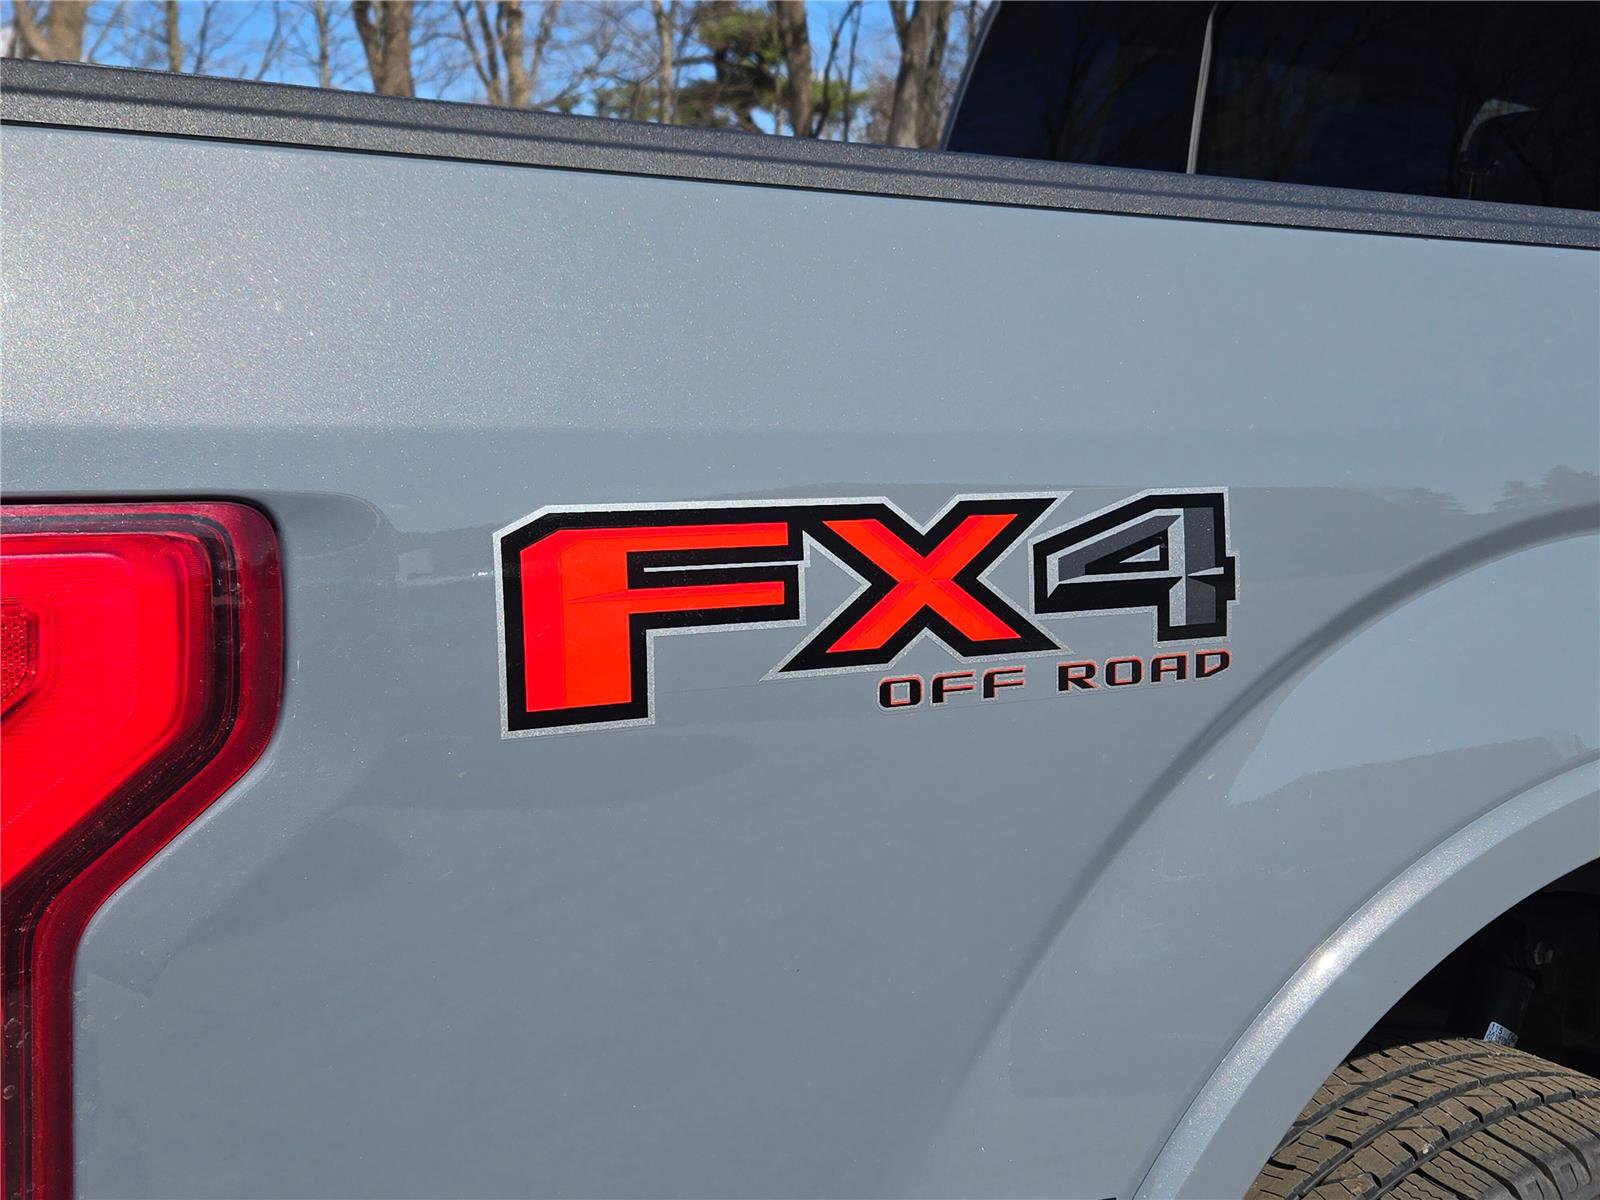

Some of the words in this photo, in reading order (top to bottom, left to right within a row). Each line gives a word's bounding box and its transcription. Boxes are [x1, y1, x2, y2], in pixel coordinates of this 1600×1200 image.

[494, 487, 1238, 738] FX4
[879, 667, 1024, 708] OFF
[1057, 650, 1232, 693] ROAD
